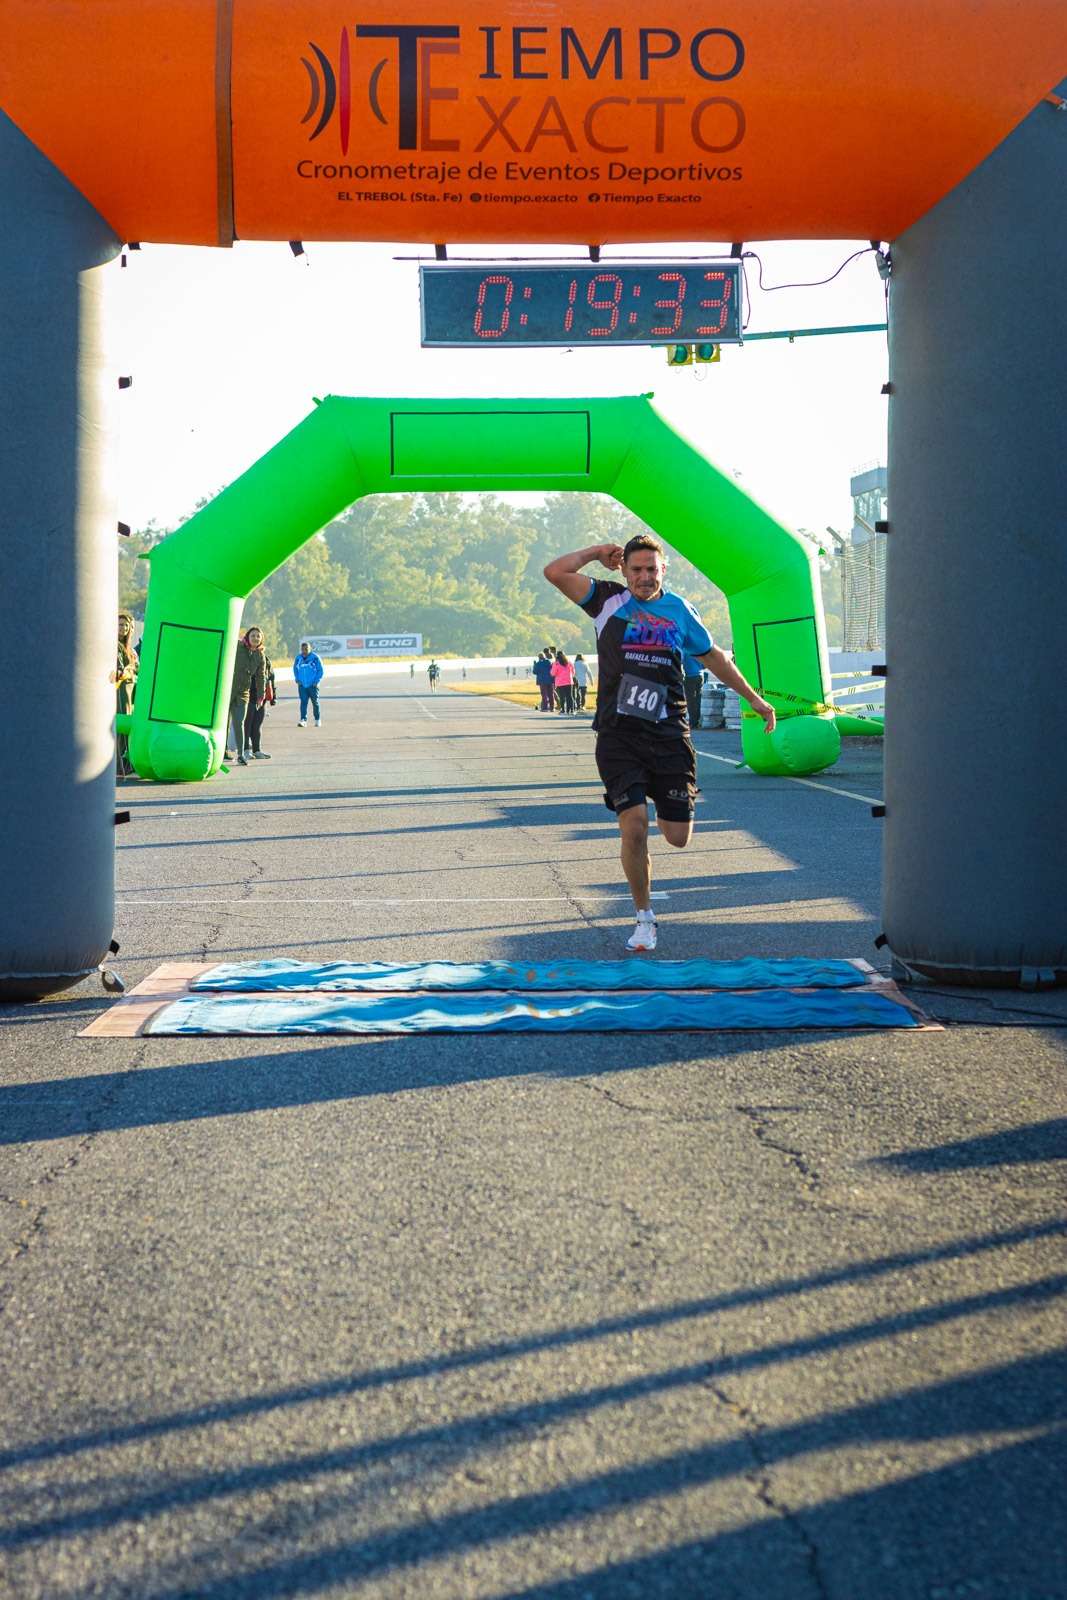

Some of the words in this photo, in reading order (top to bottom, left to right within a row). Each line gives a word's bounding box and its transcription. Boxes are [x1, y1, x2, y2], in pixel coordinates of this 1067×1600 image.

[297, 160, 461, 184] Cronometraje
[468, 161, 498, 180] de
[505, 162, 600, 181] Eventos
[608, 162, 743, 185] Deportivos
[338, 191, 353, 201] EL
[355, 191, 407, 202] TREBOL
[410, 191, 440, 203] (Sta.
[443, 192, 463, 203] Fe)
[484, 192, 579, 205] tiempo.exacto
[602, 192, 654, 205] Tiempo
[657, 193, 702, 203] Exacto
[310, 640, 335, 652] Ford
[368, 638, 413, 648] LONG
[626, 685, 658, 712] 140
